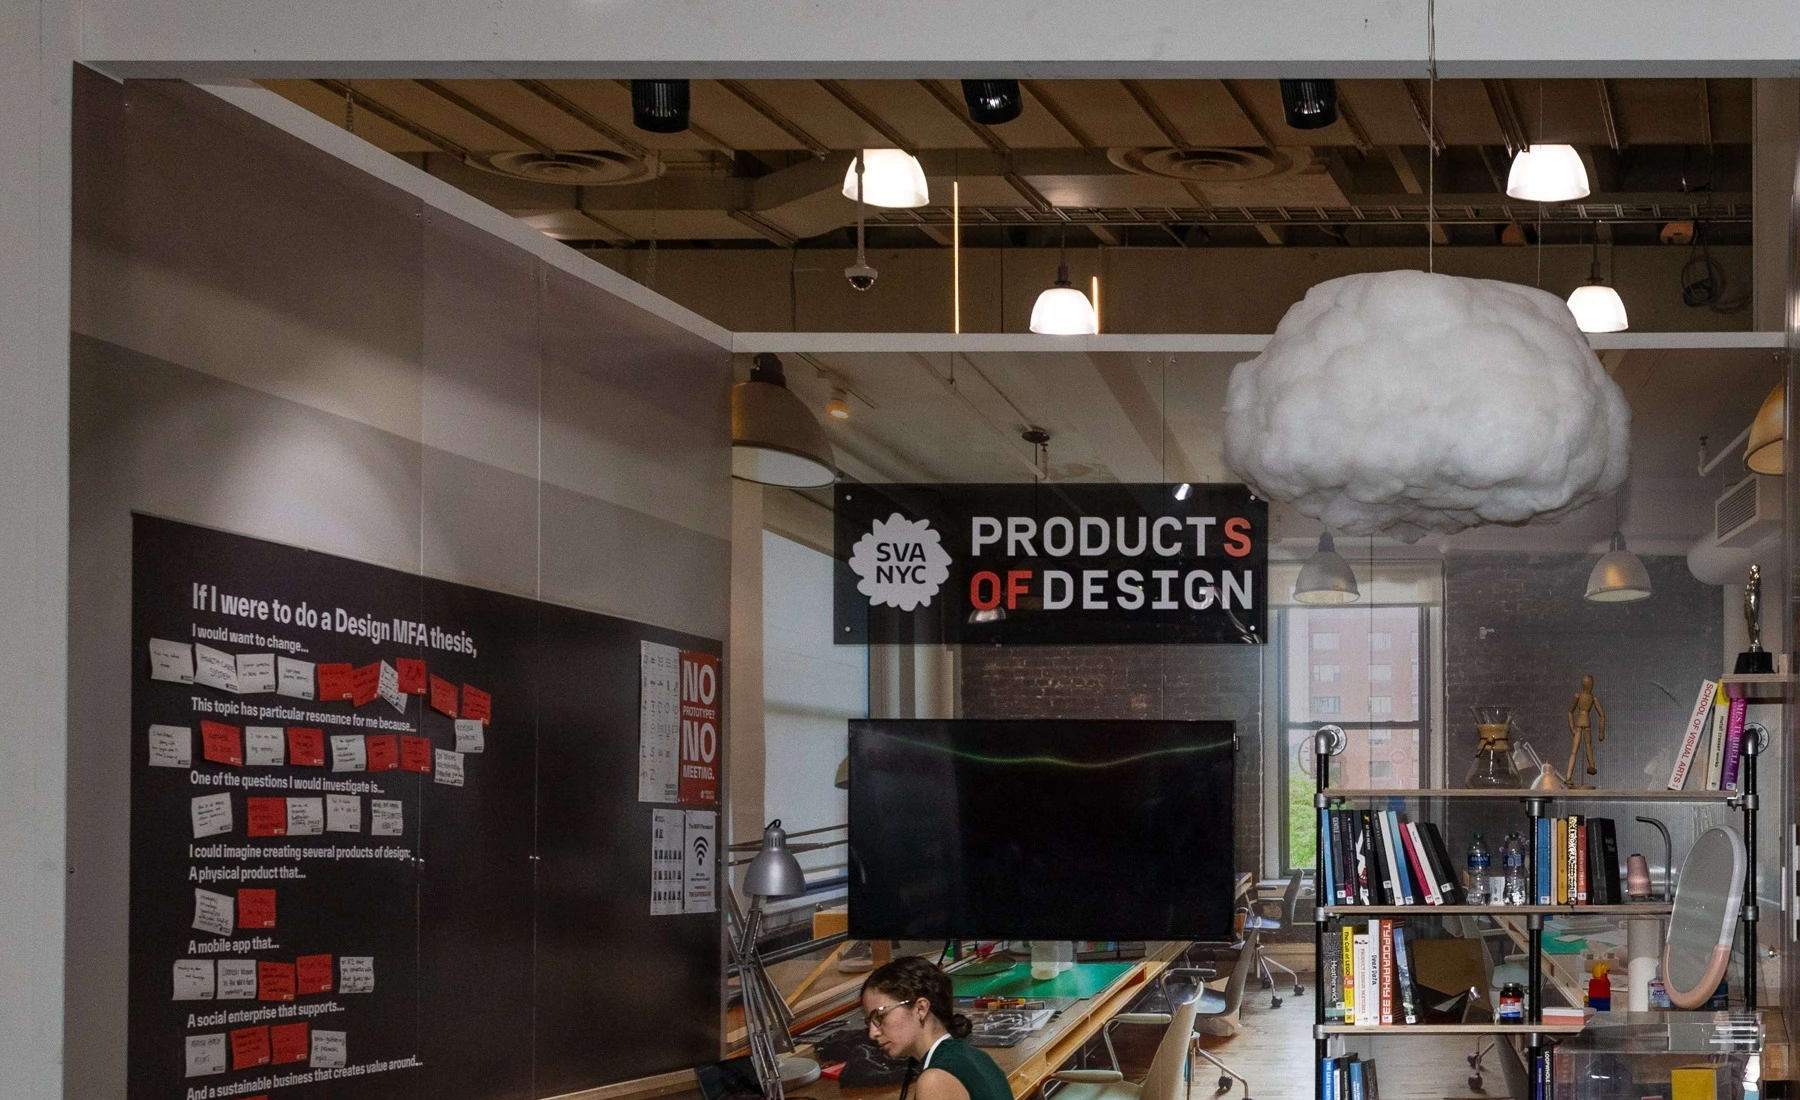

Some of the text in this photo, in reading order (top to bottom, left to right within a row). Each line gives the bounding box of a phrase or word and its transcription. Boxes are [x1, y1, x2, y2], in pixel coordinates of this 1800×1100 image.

[875, 542, 927, 562] SVA
[971, 515, 1253, 558] PRODUCTS
[875, 565, 927, 585] NYC
[970, 569, 1253, 611] OF DESIGN
[192, 582, 477, 658] If I were to do a Design MFA thesis,
[197, 626, 229, 642] would
[229, 632, 254, 645] want
[255, 634, 266, 647] to
[266, 636, 309, 654] change...
[683, 660, 716, 705] NO
[191, 696, 417, 733] This topic has particular resonance for me because...
[682, 705, 715, 720] PROTOTYPE?
[682, 719, 717, 764] NO
[1673, 683, 1714, 784] SCHOOL OF VISUAL ARTS
[190, 770, 211, 785] One
[212, 771, 223, 785] of
[223, 772, 240, 786] the
[241, 774, 288, 789] questions
[294, 776, 321, 789] would
[322, 777, 369, 794] investigate
[370, 780, 385, 794] is...
[682, 765, 715, 780] MEETING.
[194, 844, 223, 858] could
[223, 844, 262, 861] imagine
[263, 845, 301, 861] creating
[302, 845, 336, 858] several
[336, 846, 374, 861] products
[374, 846, 384, 858] of
[383, 846, 411, 861] design:
[189, 866, 306, 883] A physical product that...
[188, 936, 280, 954] A mobile app that...
[1330, 960, 1339, 1002] Heatherwick
[1383, 923, 1391, 1015] TYPOGRAPHY 33
[187, 1001, 345, 1028] A social enterprise that supports...
[208, 1089, 215, 1099] a
[216, 1078, 272, 1097] sustainable
[273, 1073, 313, 1089] business
[314, 1069, 333, 1082] that
[333, 1065, 366, 1079] creates
[366, 1061, 388, 1073] value
[388, 1054, 423, 1071] around...
